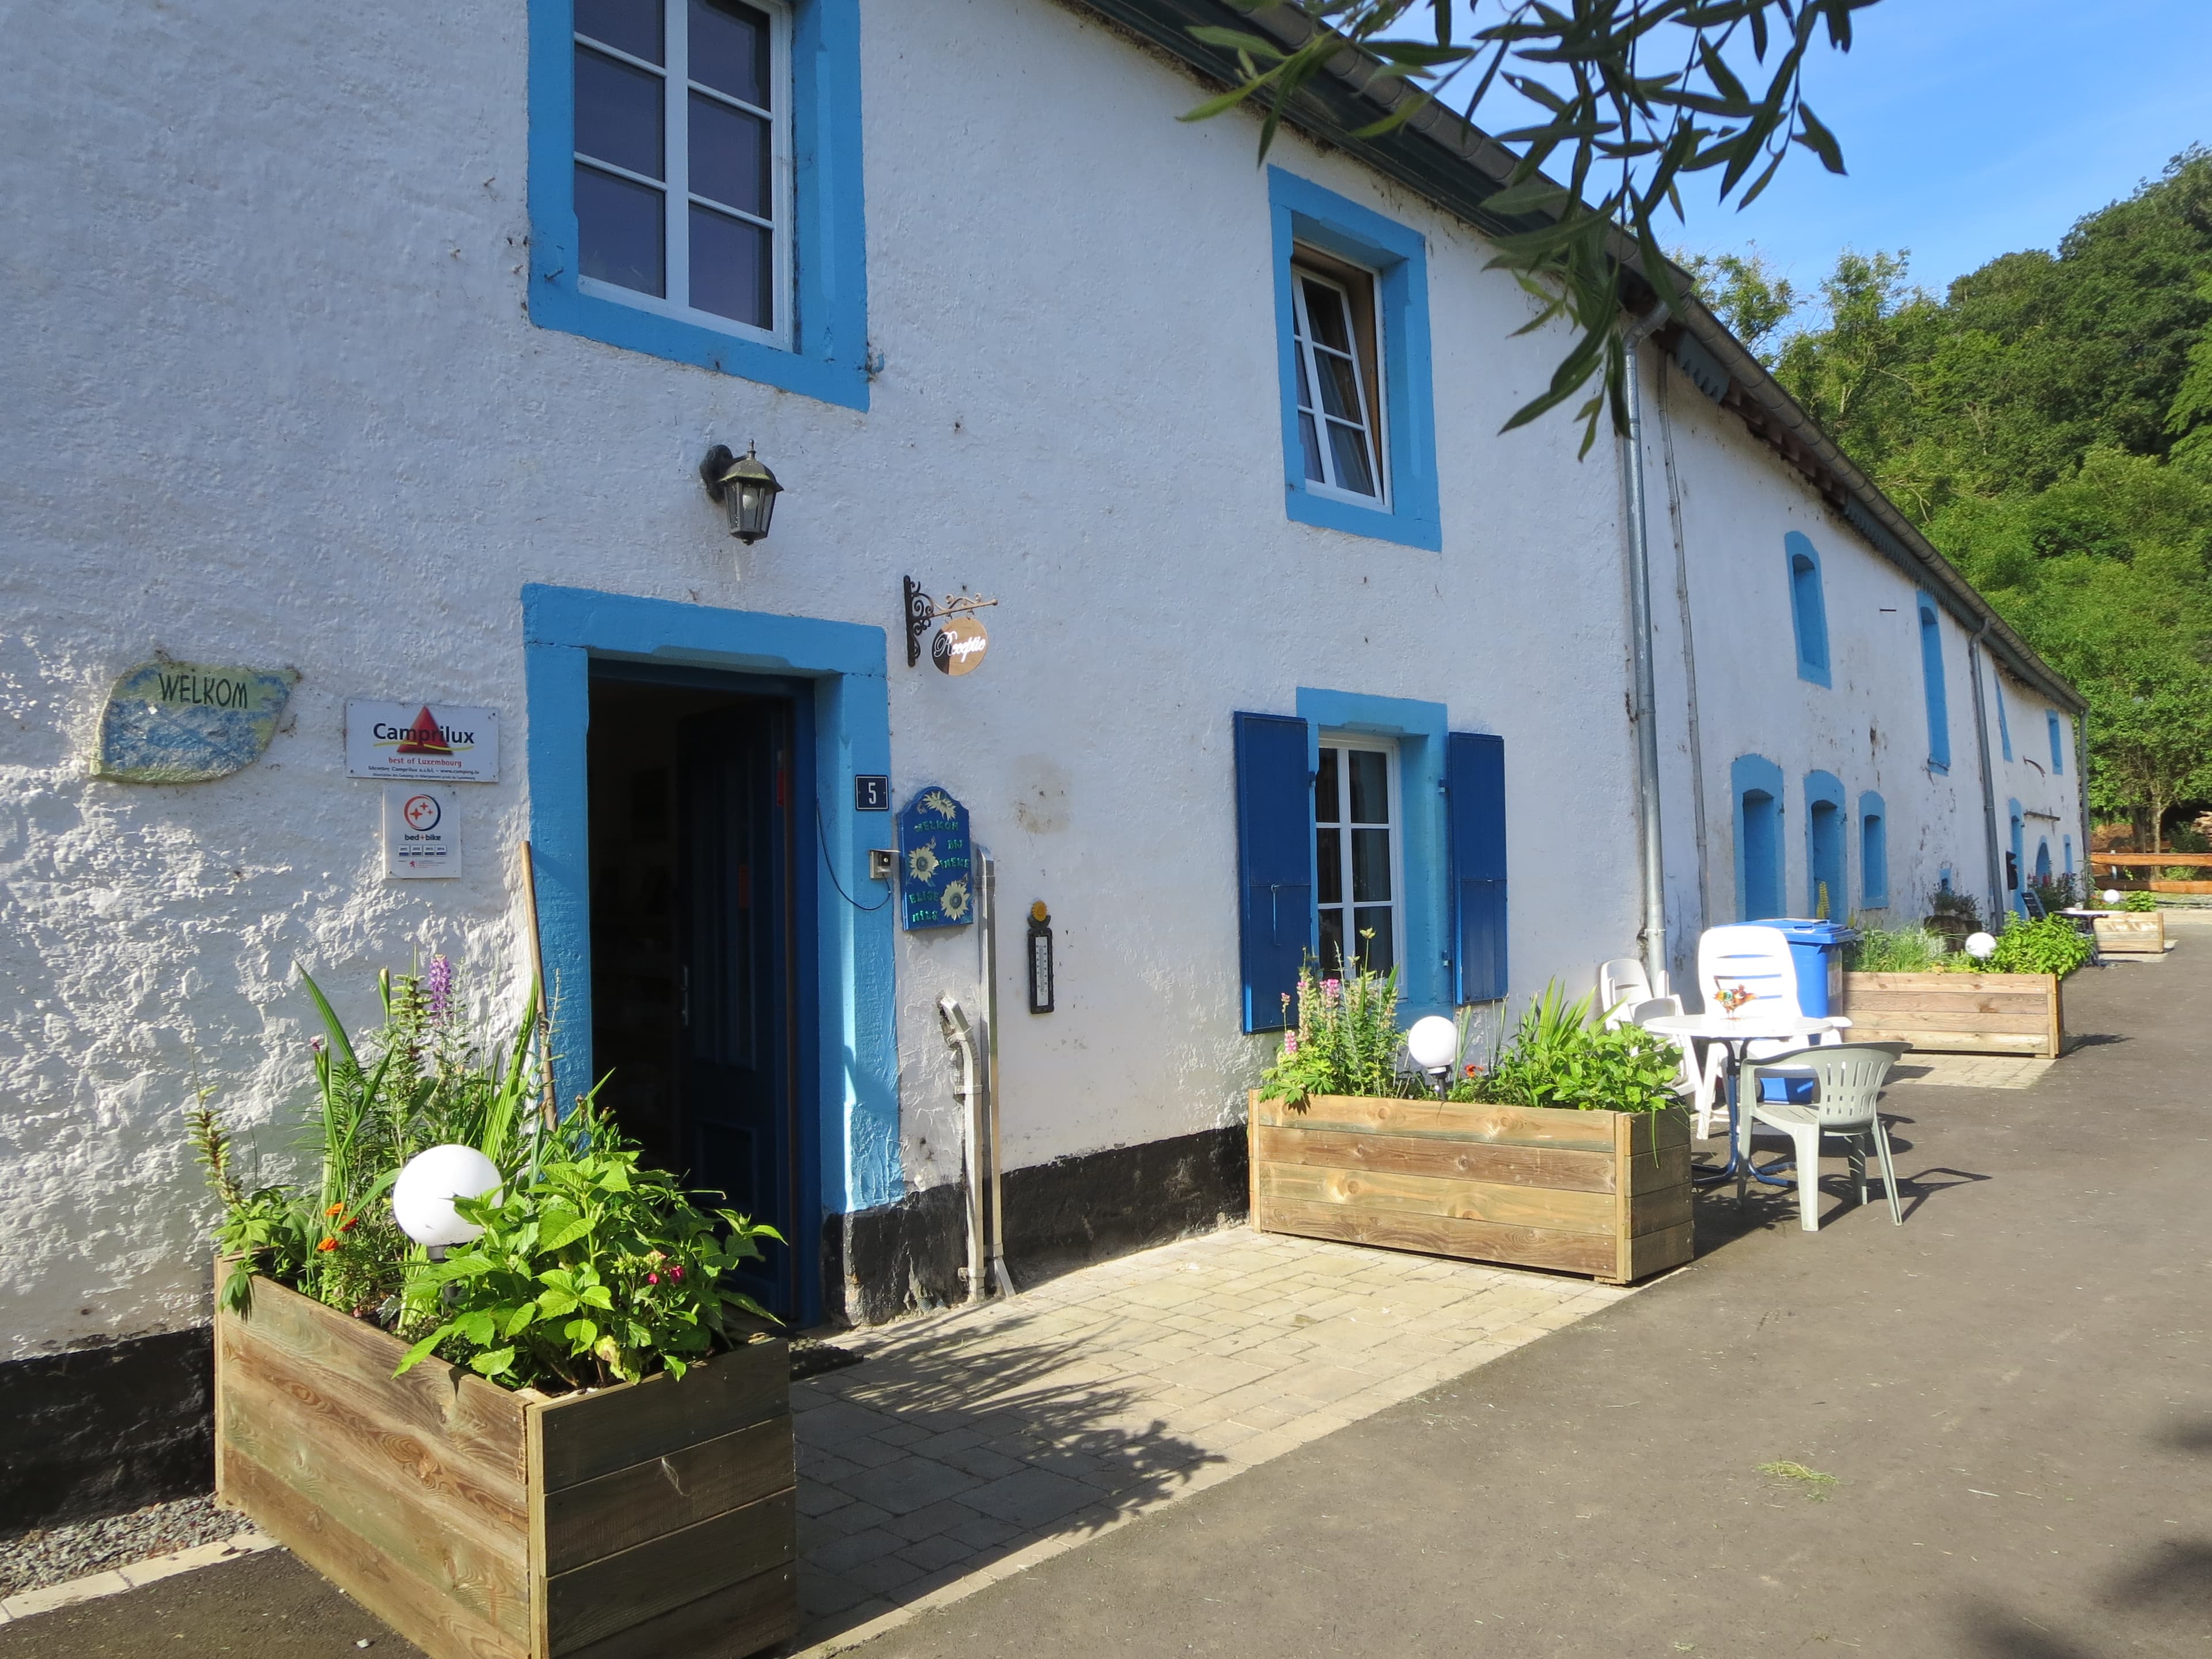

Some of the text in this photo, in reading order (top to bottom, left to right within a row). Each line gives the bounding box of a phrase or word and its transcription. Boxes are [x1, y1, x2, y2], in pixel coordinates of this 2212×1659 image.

[933, 631, 987, 662] Receptie
[158, 673, 248, 709] WELKOM
[373, 723, 475, 745] Camprilux
[388, 756, 404, 764] best
[418, 758, 462, 768] Luxembourg
[868, 782, 877, 805] 5
[914, 820, 960, 833] WELKOM
